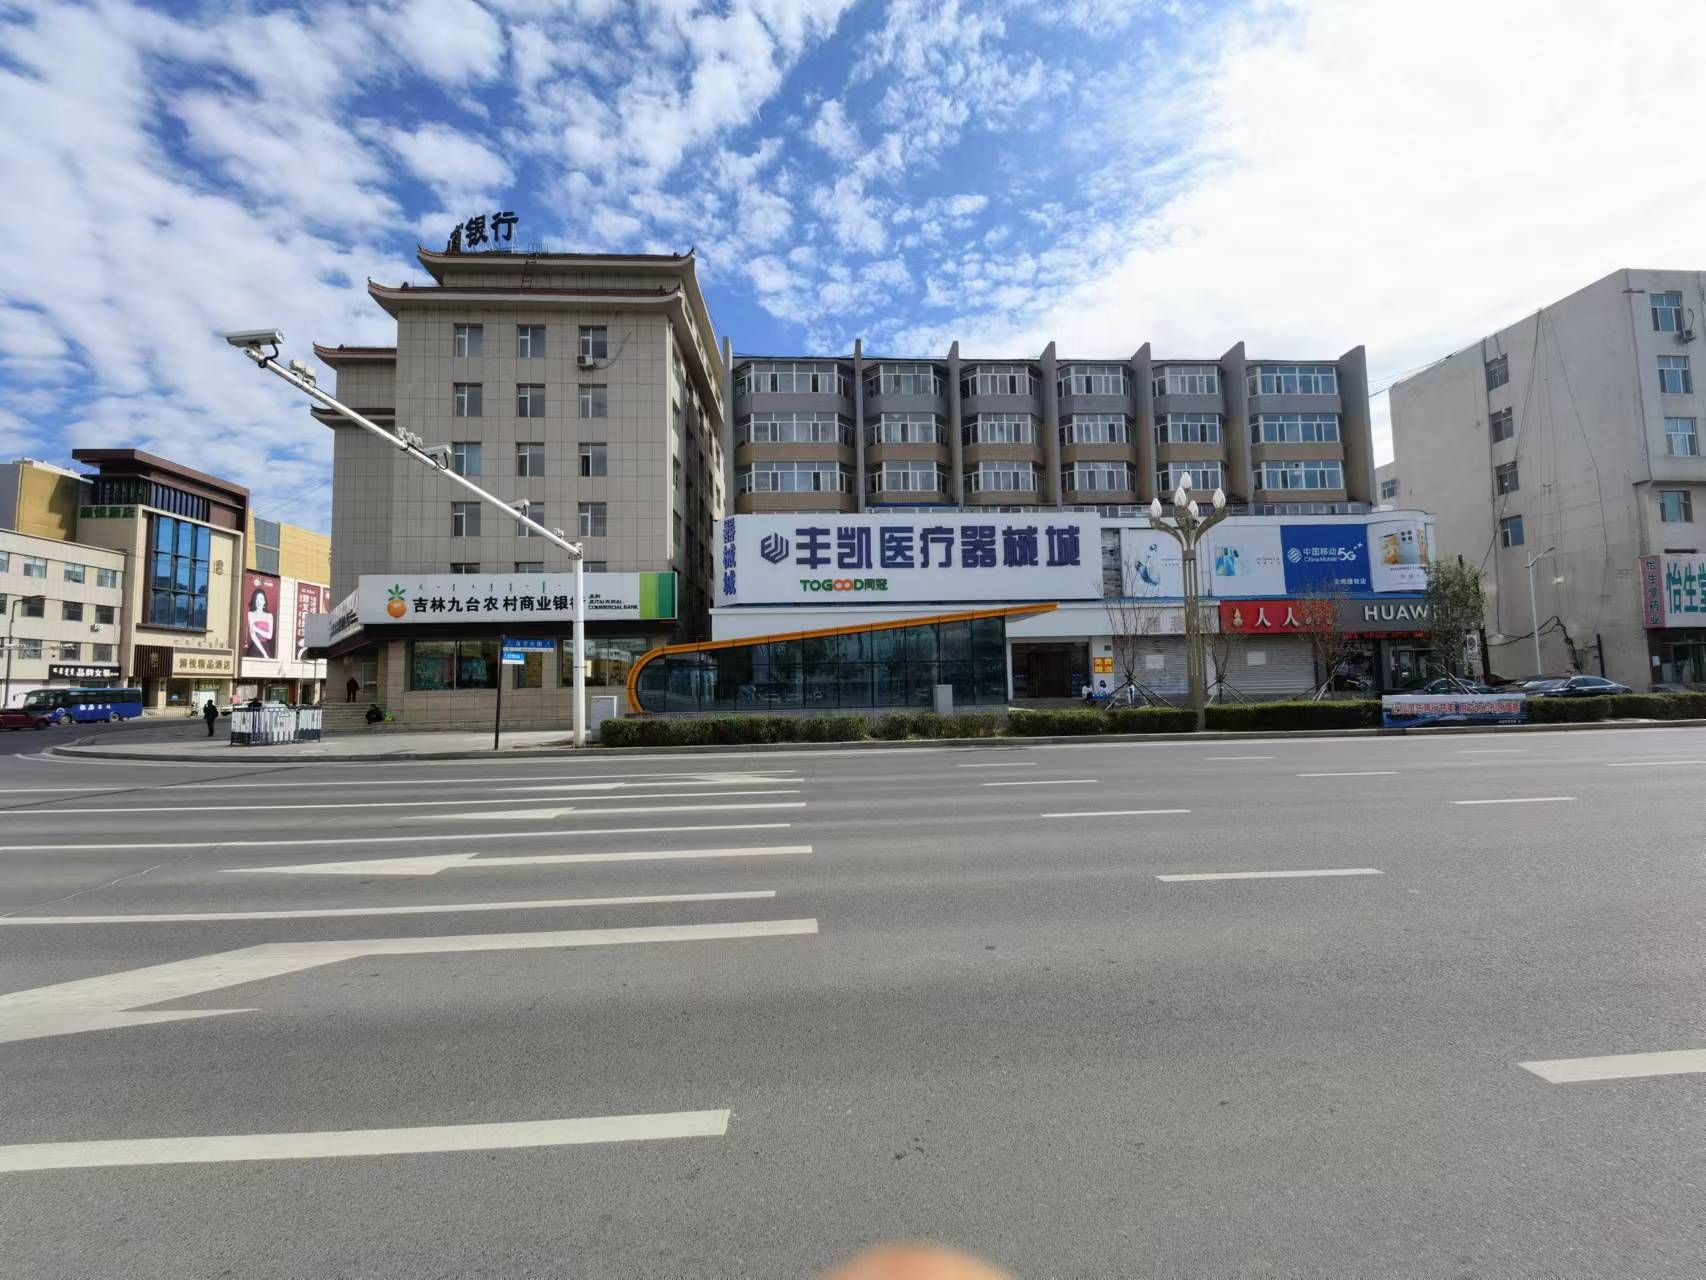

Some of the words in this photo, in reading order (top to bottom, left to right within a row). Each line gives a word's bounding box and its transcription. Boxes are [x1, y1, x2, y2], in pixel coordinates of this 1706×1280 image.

[795, 525, 1081, 570] 丰凯医疗器械城
[1303, 547, 1337, 556] 中国移动
[1337, 547, 1357, 561] 5G
